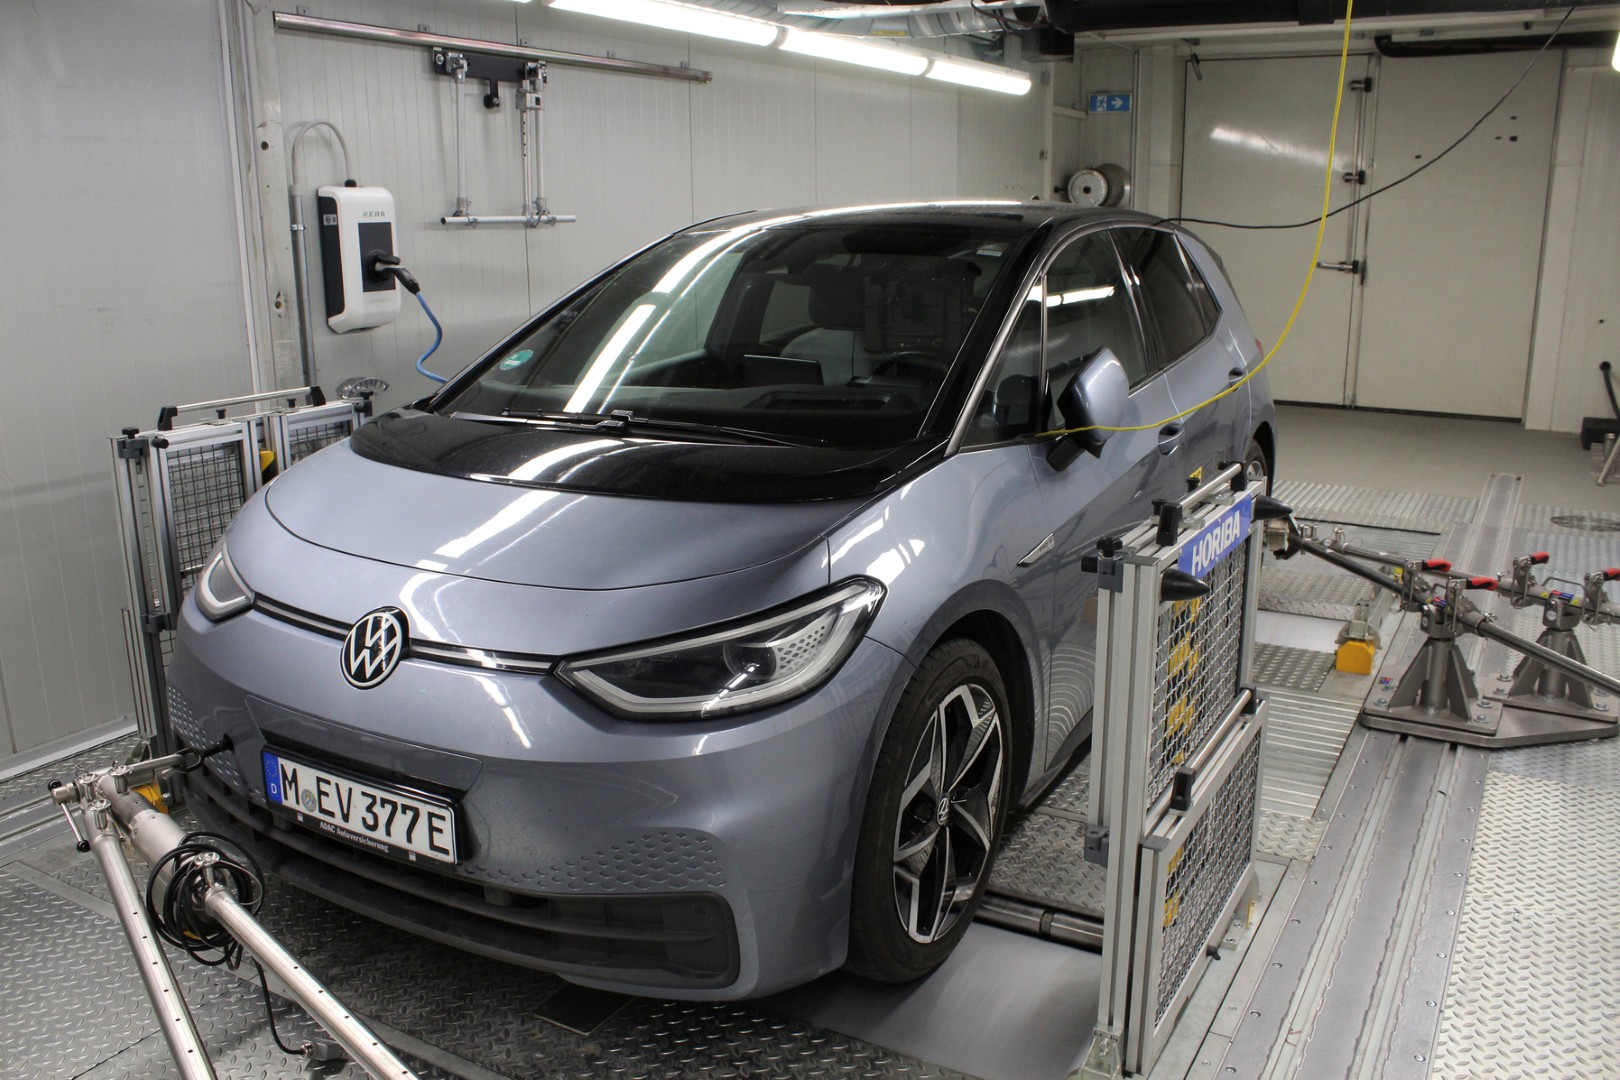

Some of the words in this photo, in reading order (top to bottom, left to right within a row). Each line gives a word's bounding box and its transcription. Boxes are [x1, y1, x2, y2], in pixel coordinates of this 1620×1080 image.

[1191, 510, 1241, 576] HORIBA
[270, 782, 278, 794] D
[280, 763, 300, 805] M
[316, 776, 353, 823] EV
[361, 791, 450, 856] 377E
[319, 821, 336, 833] ADAC
[336, 828, 389, 853] Autoversicherung
